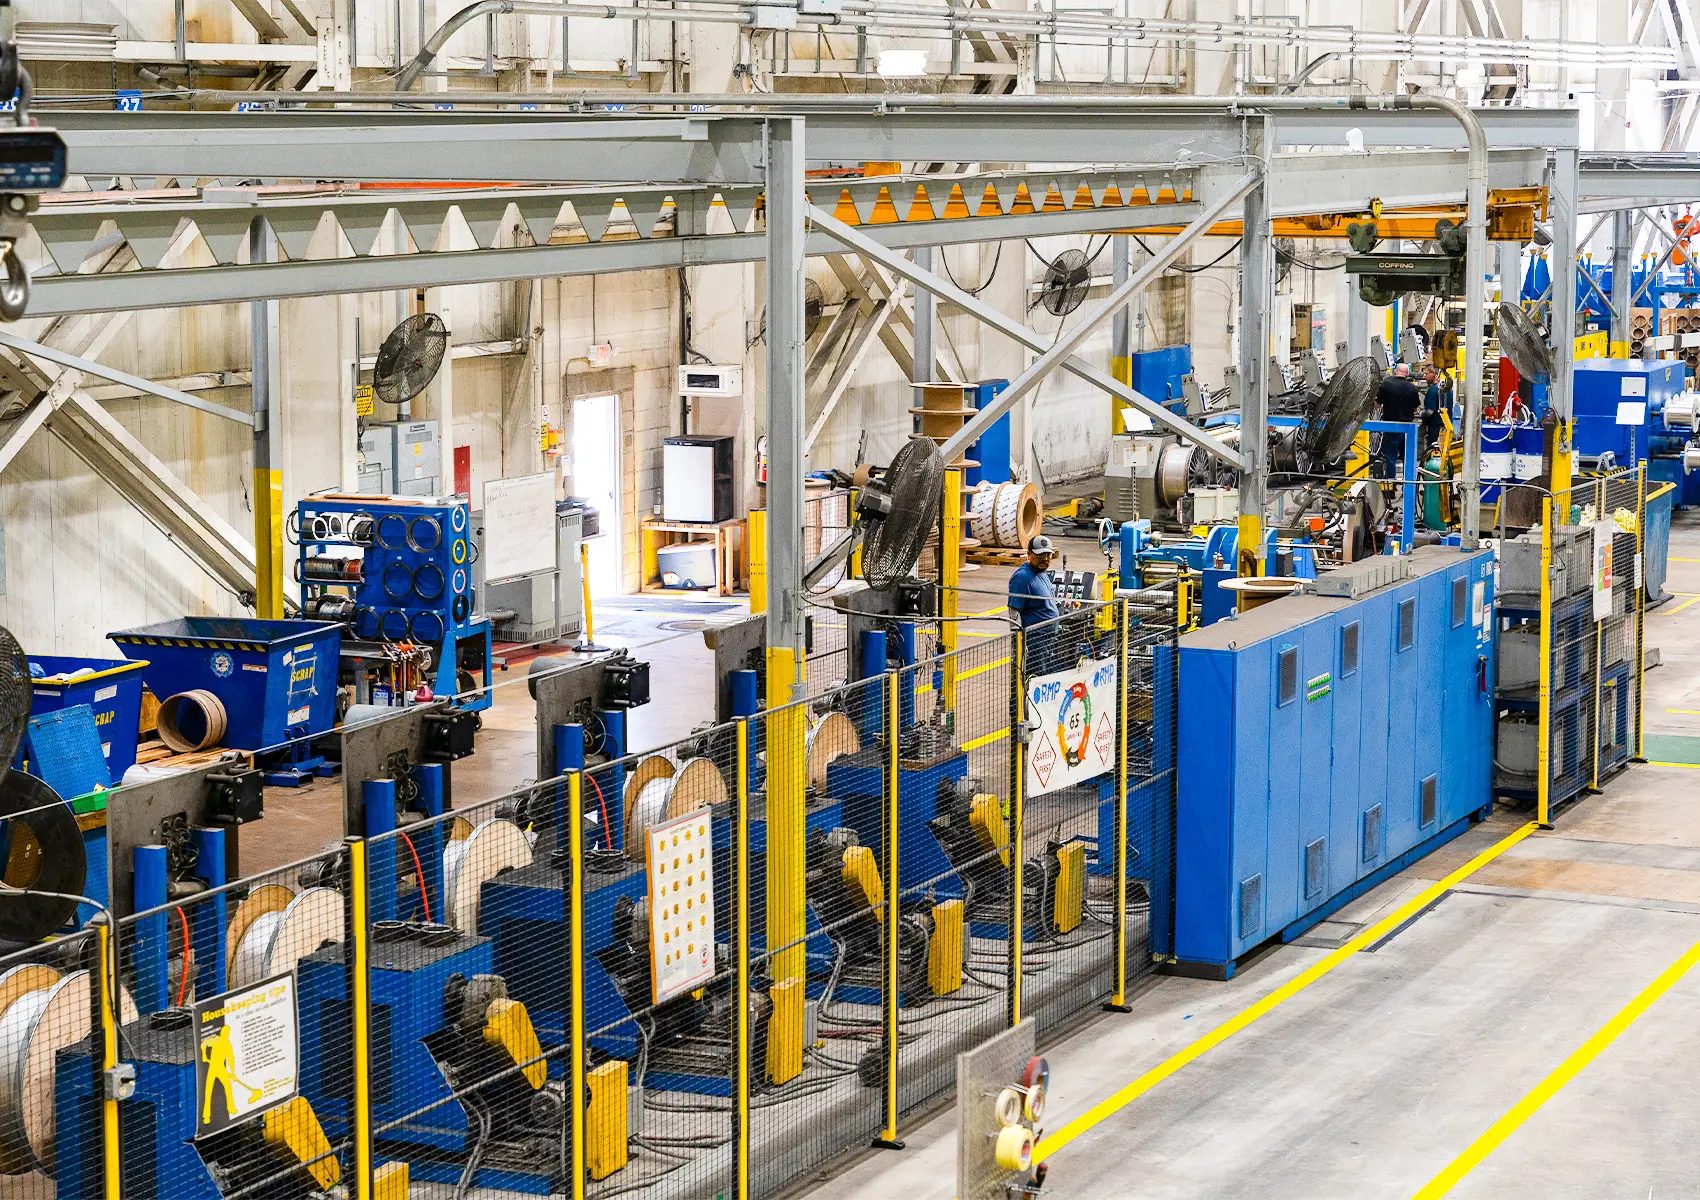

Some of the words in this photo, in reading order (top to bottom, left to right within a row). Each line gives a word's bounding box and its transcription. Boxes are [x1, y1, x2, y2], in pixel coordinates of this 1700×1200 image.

[292, 666, 314, 682] SCRAP
[1100, 664, 1114, 686] RMP
[1041, 681, 1061, 702] RMP
[93, 710, 115, 726] CRAP
[202, 992, 266, 1023] Housekeeping
